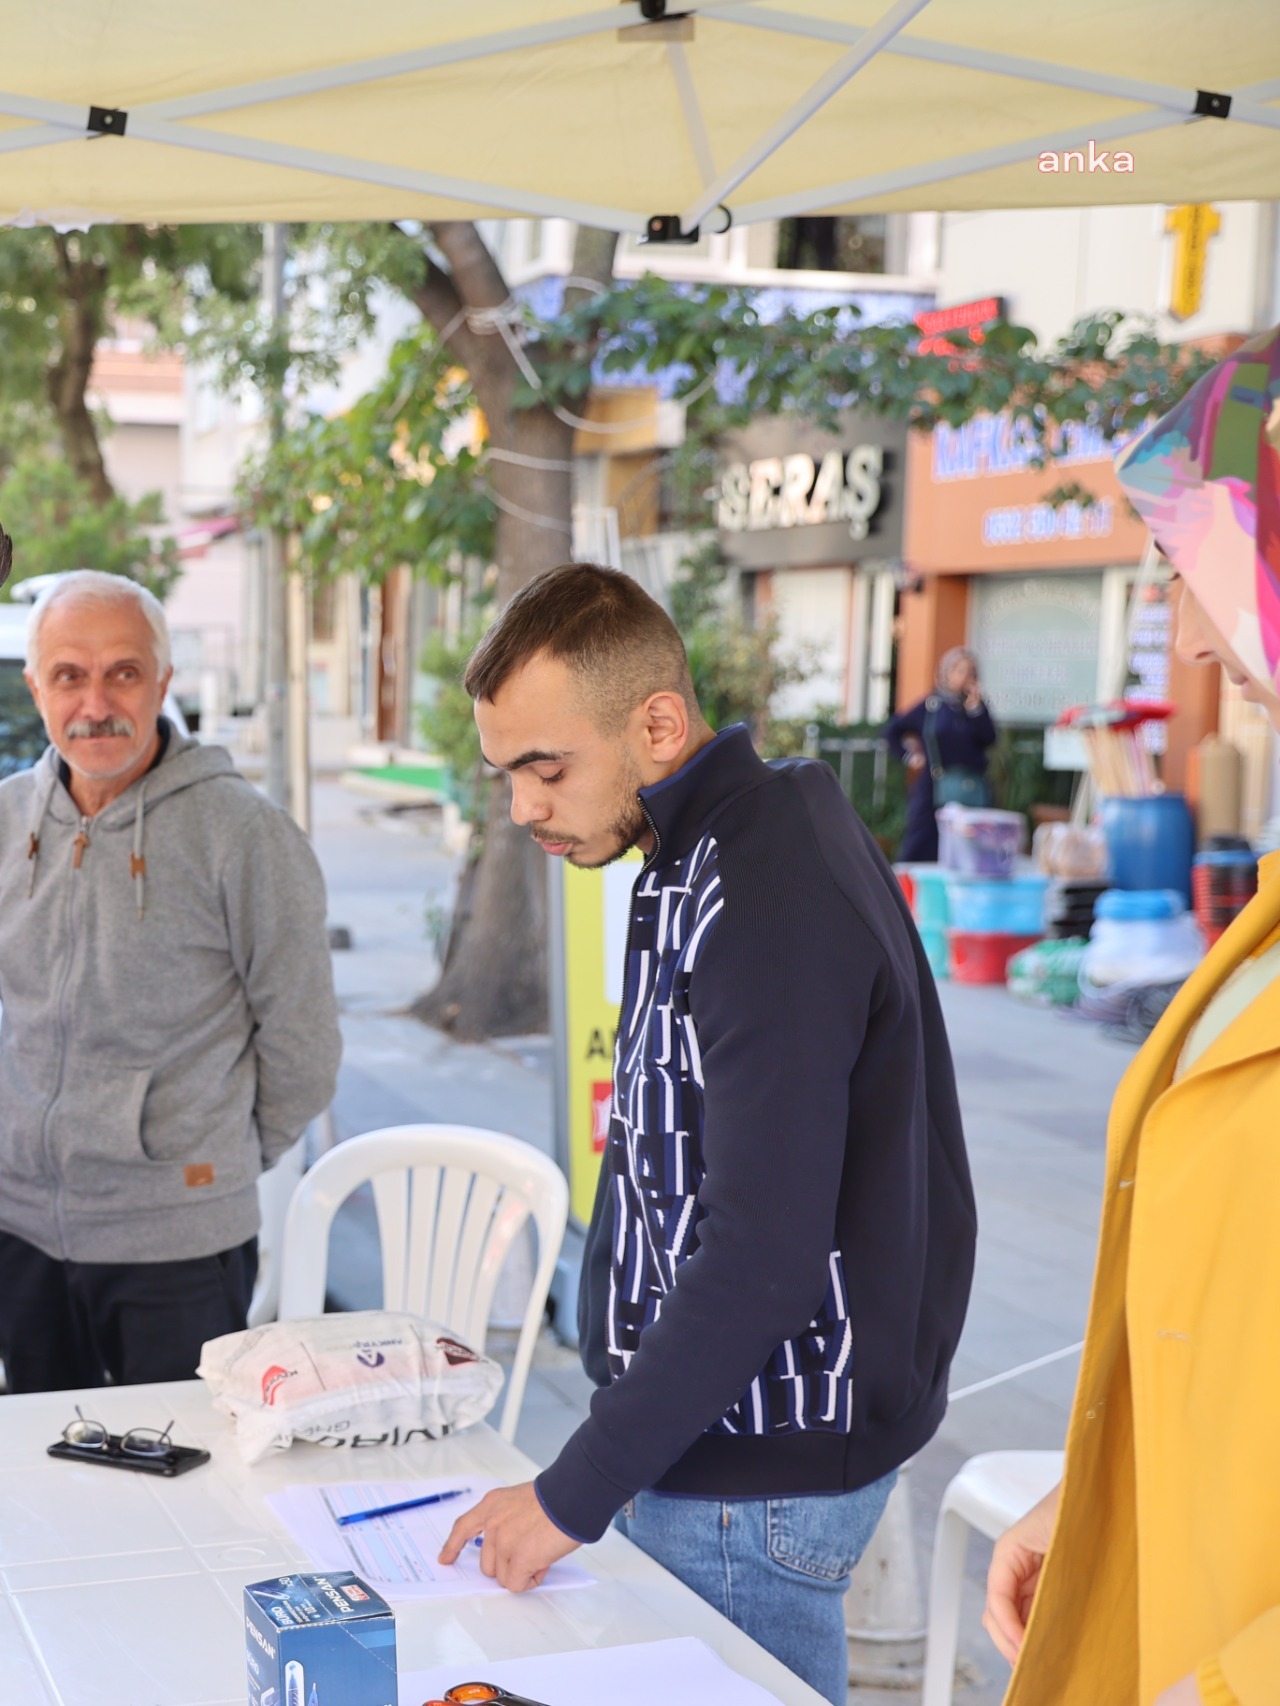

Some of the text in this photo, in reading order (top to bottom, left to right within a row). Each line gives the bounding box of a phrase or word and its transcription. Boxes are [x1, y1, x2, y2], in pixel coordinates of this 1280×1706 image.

[718, 443, 884, 541] SERAŞ
[316, 1576, 354, 1613] PENSAN
[246, 1616, 275, 1659] PENSAN
